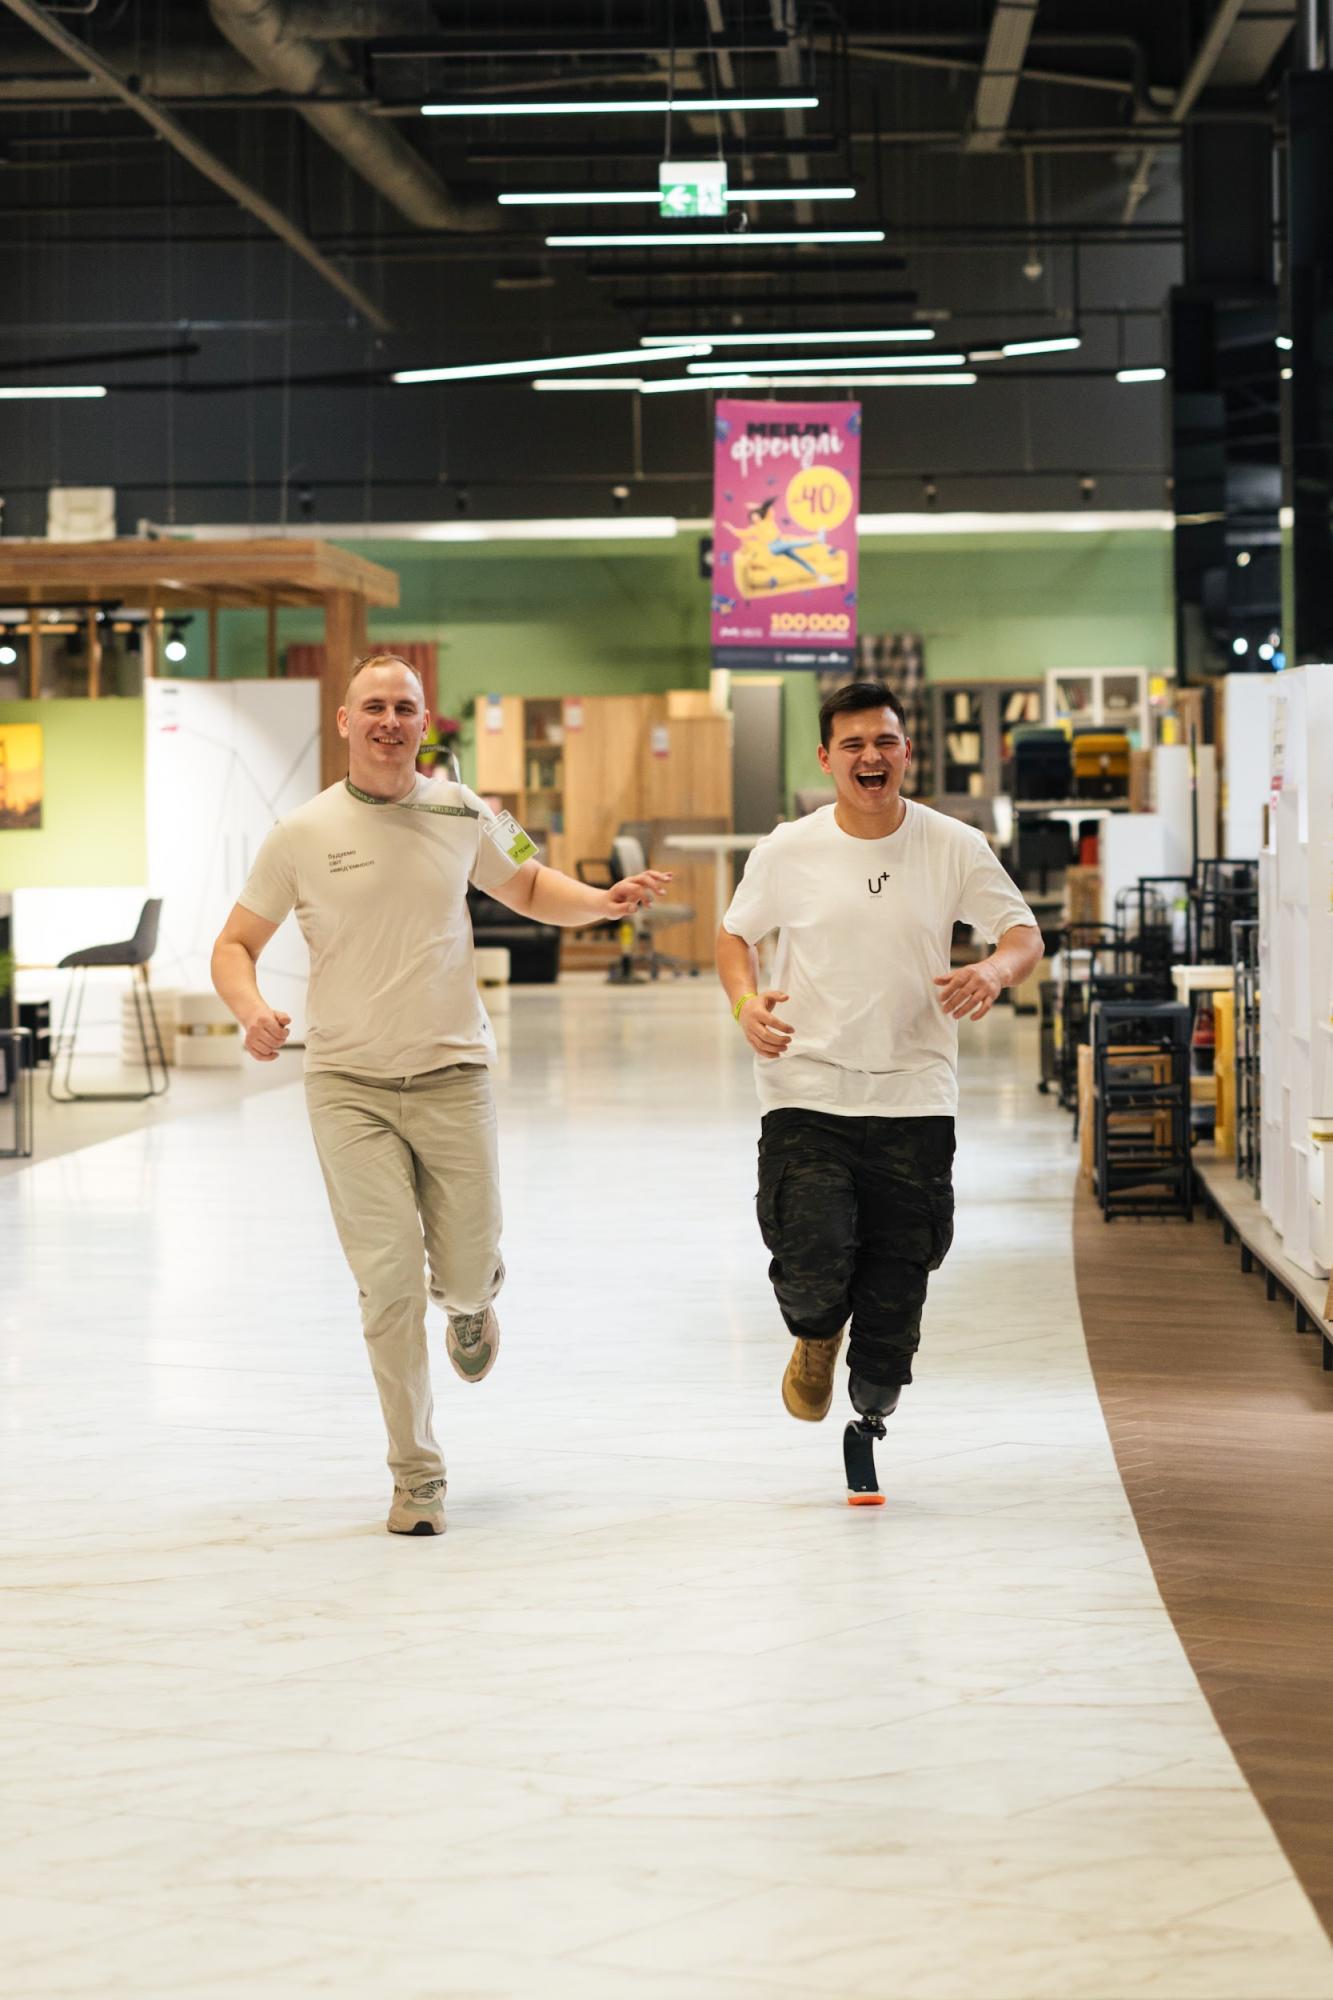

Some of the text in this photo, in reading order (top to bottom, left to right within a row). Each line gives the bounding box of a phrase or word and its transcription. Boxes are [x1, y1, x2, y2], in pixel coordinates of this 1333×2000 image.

[770, 613, 807, 632] 100
[808, 613, 851, 633] 000
[868, 871, 891, 894] U+
